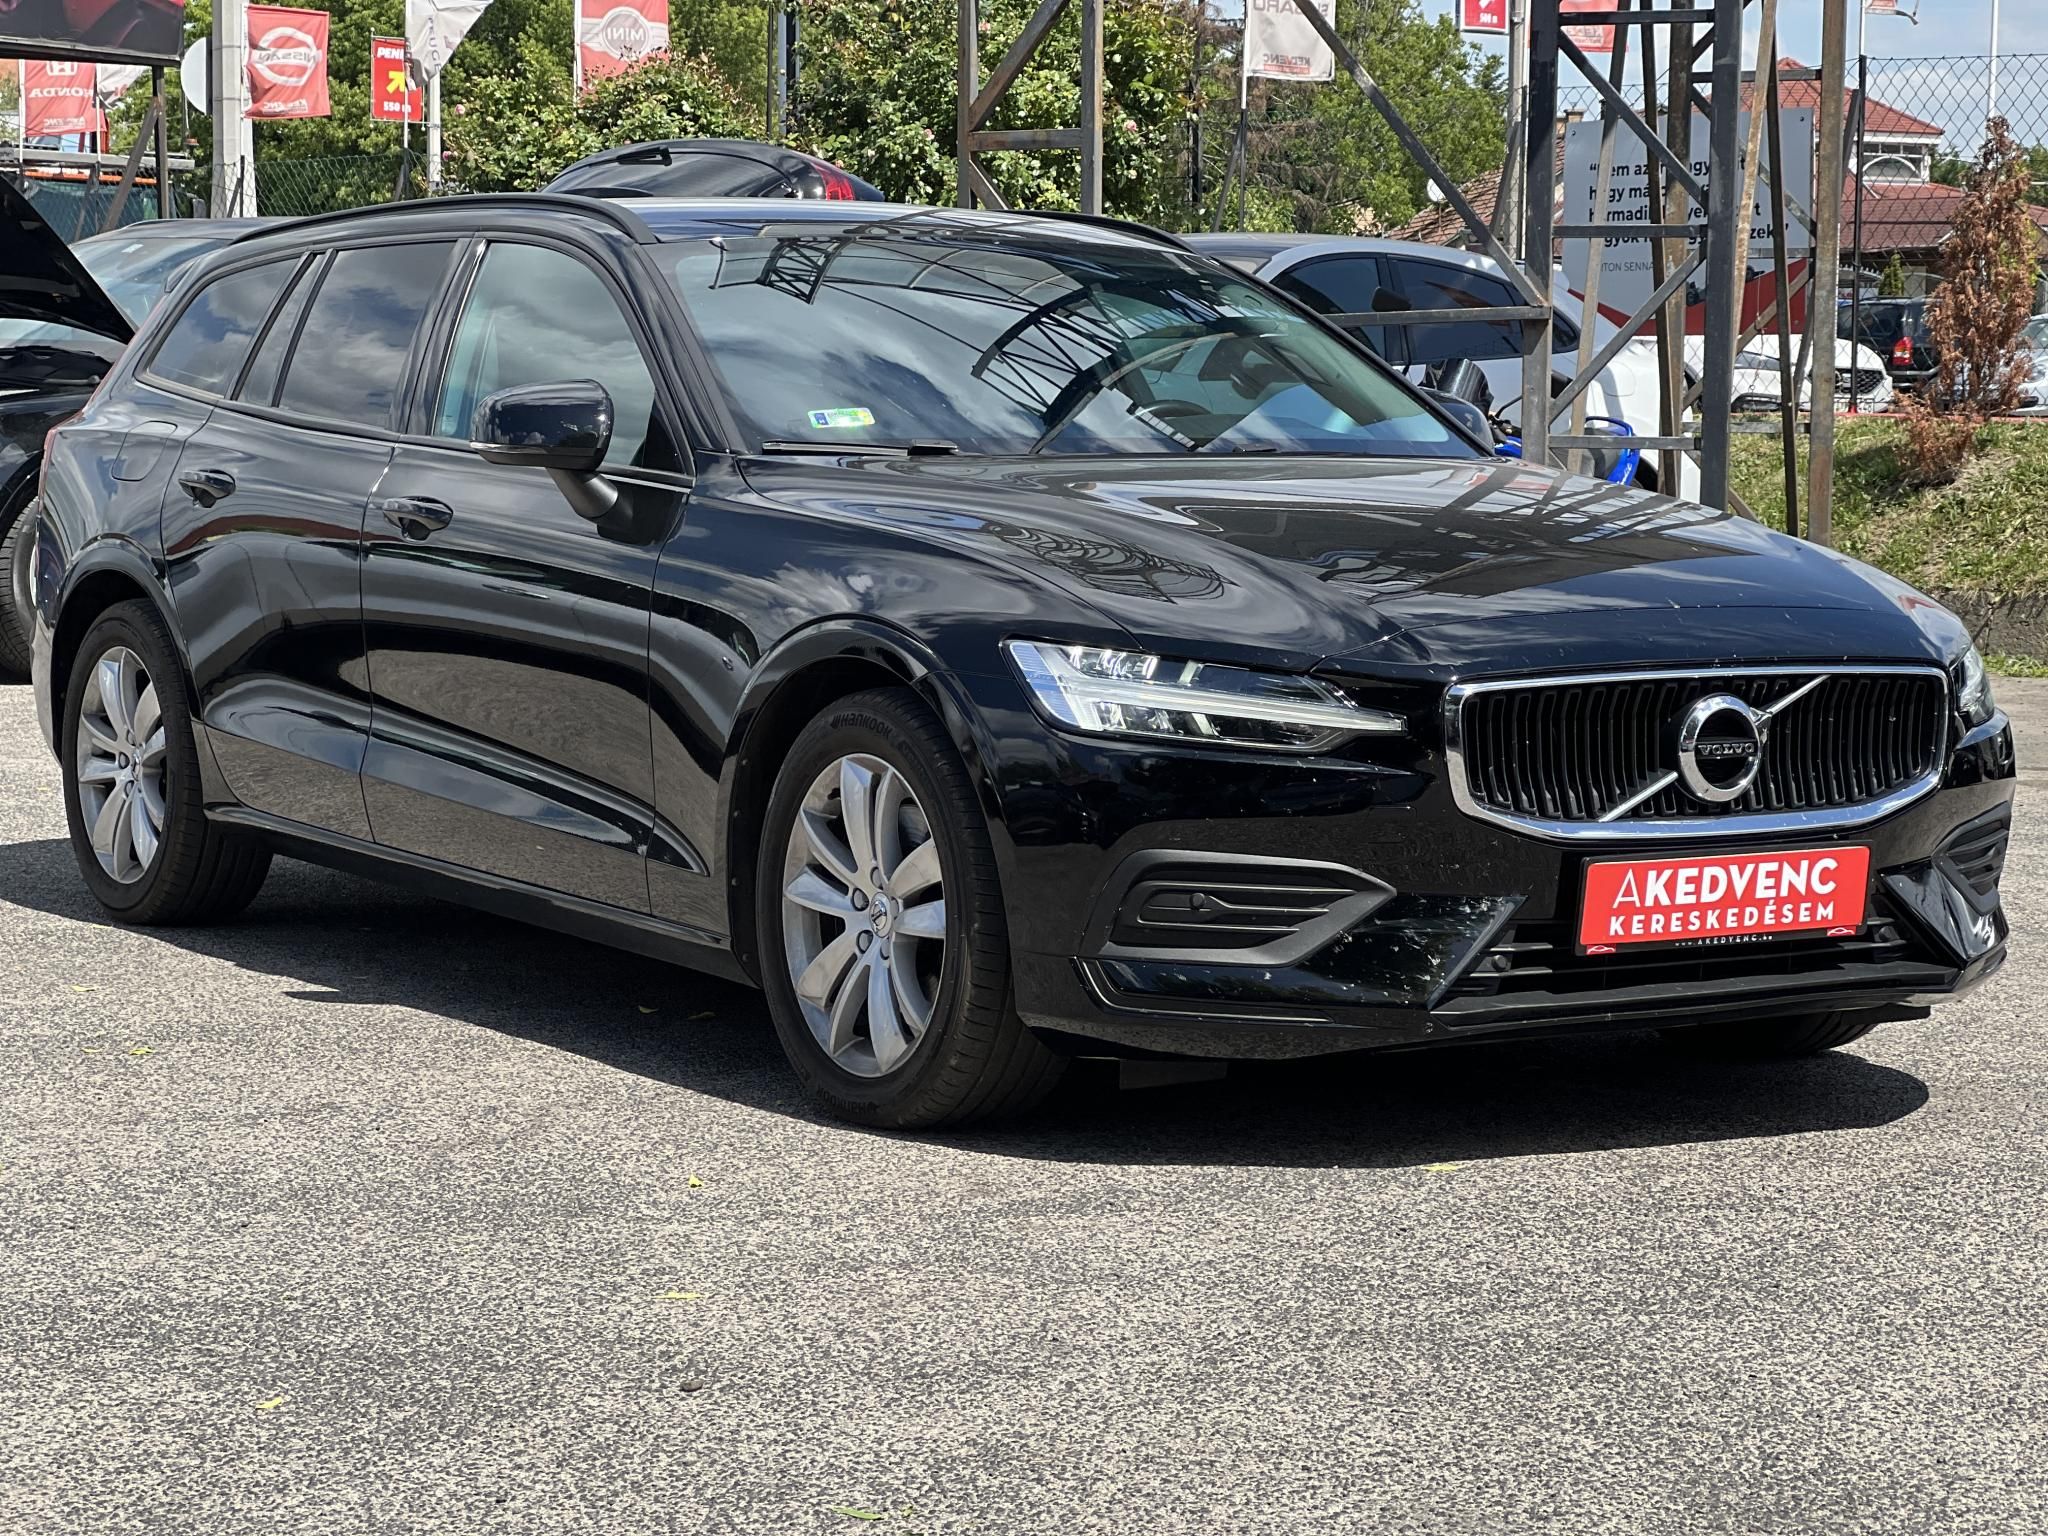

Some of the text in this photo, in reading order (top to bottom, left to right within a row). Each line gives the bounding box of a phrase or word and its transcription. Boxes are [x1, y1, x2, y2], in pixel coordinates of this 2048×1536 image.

[383, 101, 401, 112] 550
[1697, 742, 1754, 755] VOLVO
[1608, 900, 1835, 937] KERESKEDÉSEM
